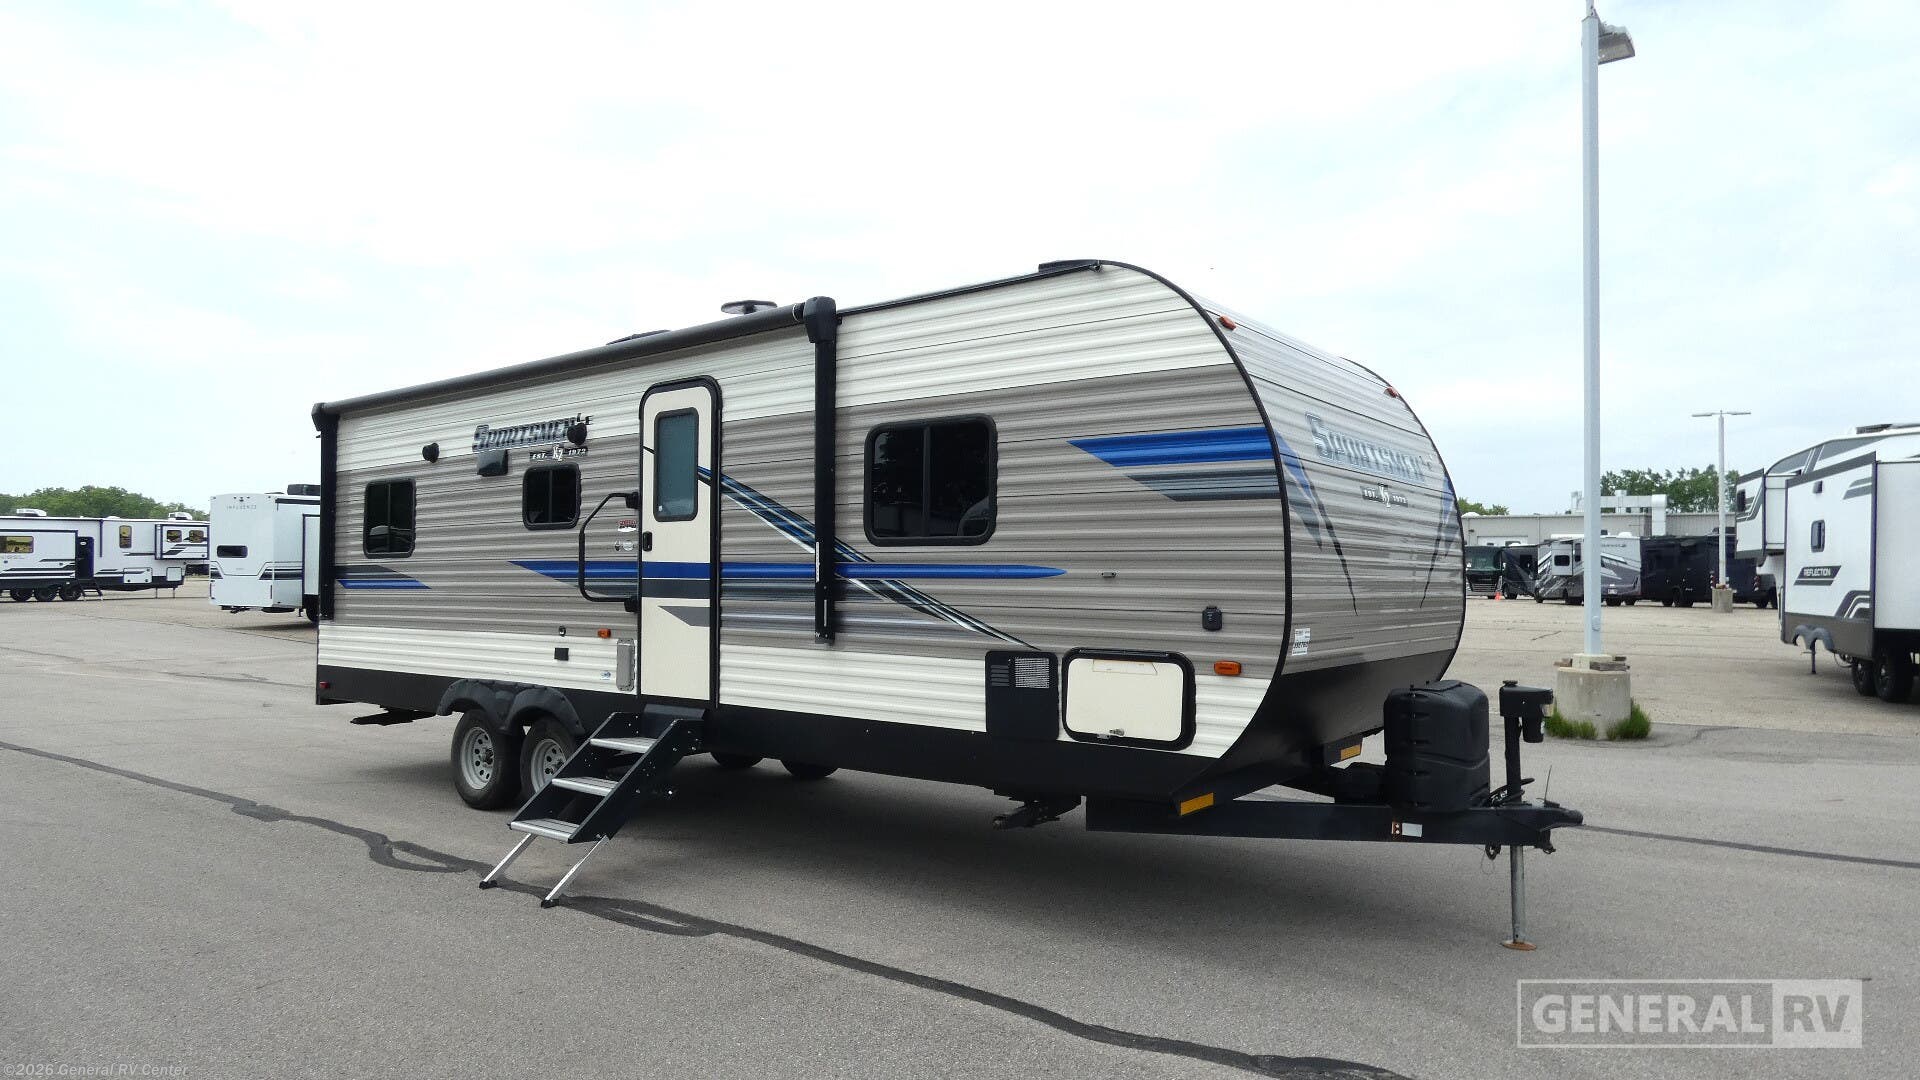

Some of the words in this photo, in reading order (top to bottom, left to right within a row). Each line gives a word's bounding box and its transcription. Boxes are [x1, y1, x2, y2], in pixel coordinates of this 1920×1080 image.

[532, 452, 548, 460] EST.
[568, 447, 587, 456] 1972
[1803, 568, 1831, 577] REFLECTION
